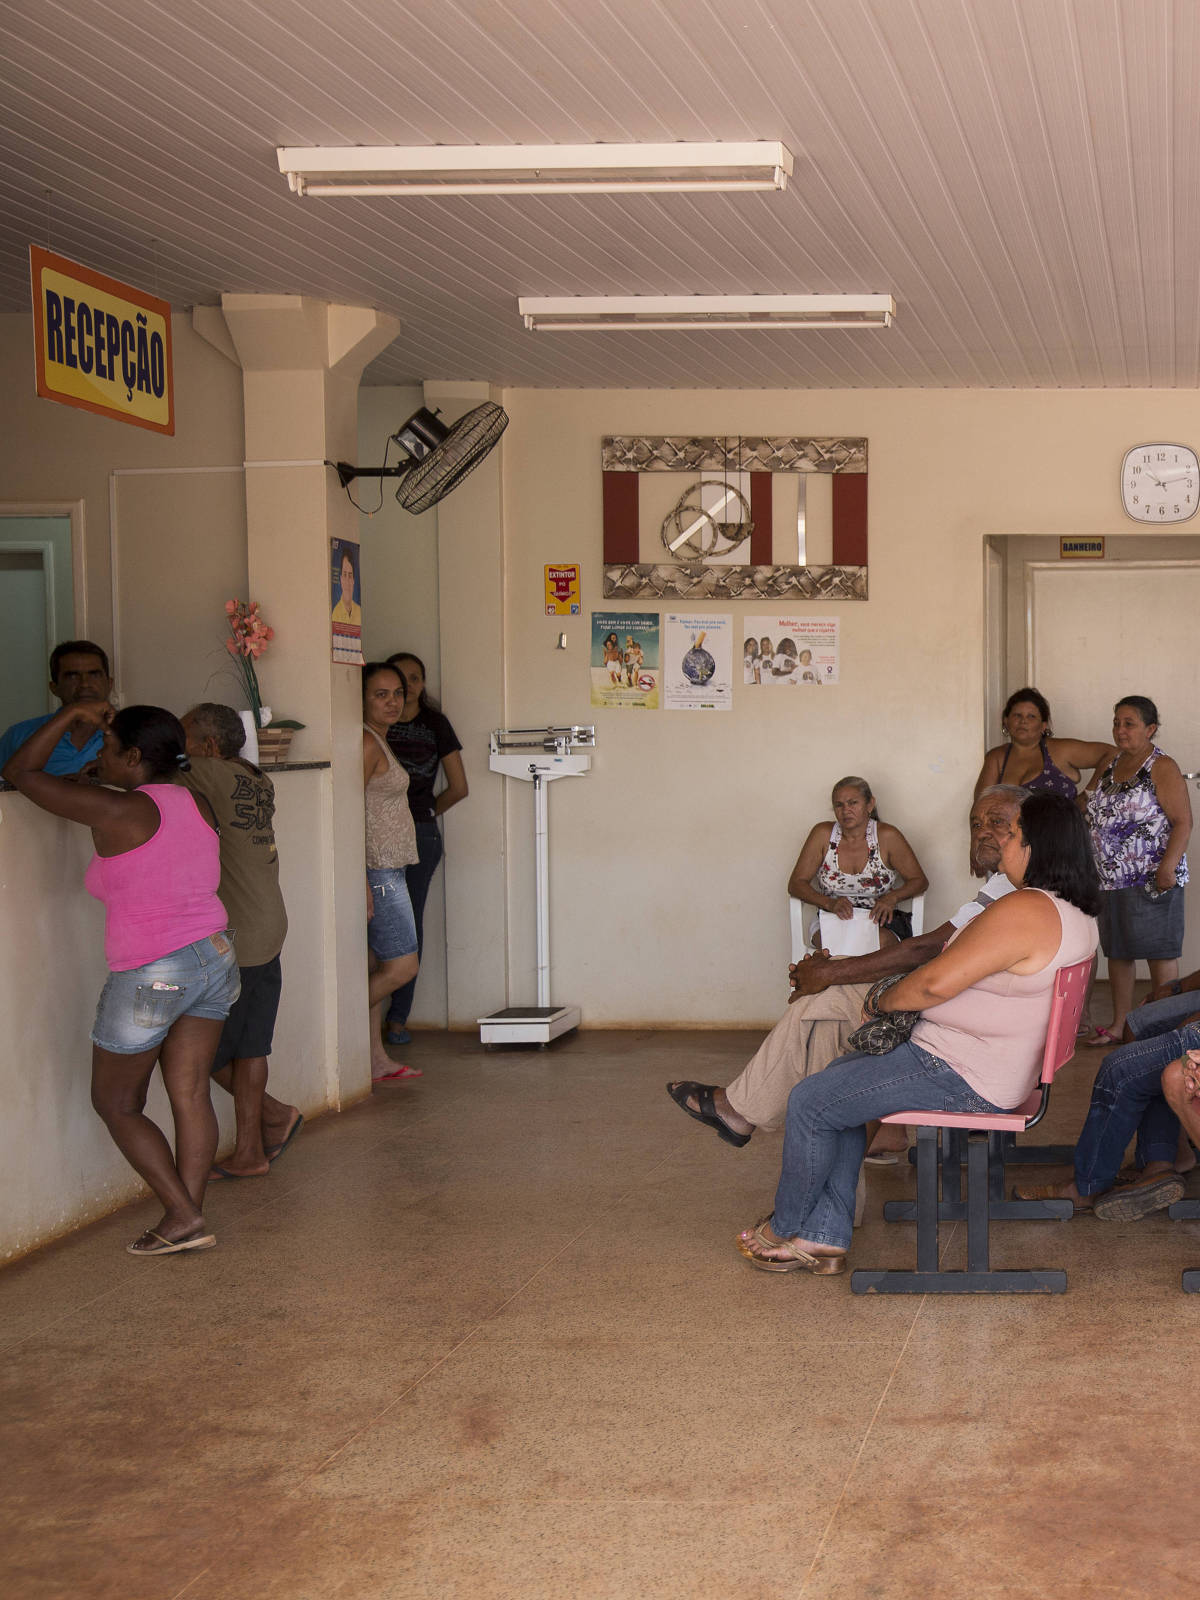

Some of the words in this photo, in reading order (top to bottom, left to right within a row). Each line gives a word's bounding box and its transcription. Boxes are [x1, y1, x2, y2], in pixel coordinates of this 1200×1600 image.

[45, 288, 165, 402] RECEPÇÃO
[1143, 455, 1151, 463] 11
[1156, 453, 1166, 462] 12
[1174, 455, 1179, 463] 1
[1132, 466, 1142, 475] 10
[1130, 481, 1137, 489] 9
[1186, 479, 1193, 488] 3
[1132, 496, 1139, 504] 8
[1184, 495, 1191, 504] 4
[1145, 505, 1151, 514] 7
[1159, 507, 1165, 516] 6
[1173, 505, 1180, 514] 5
[1062, 542, 1102, 552] BANHEIRO
